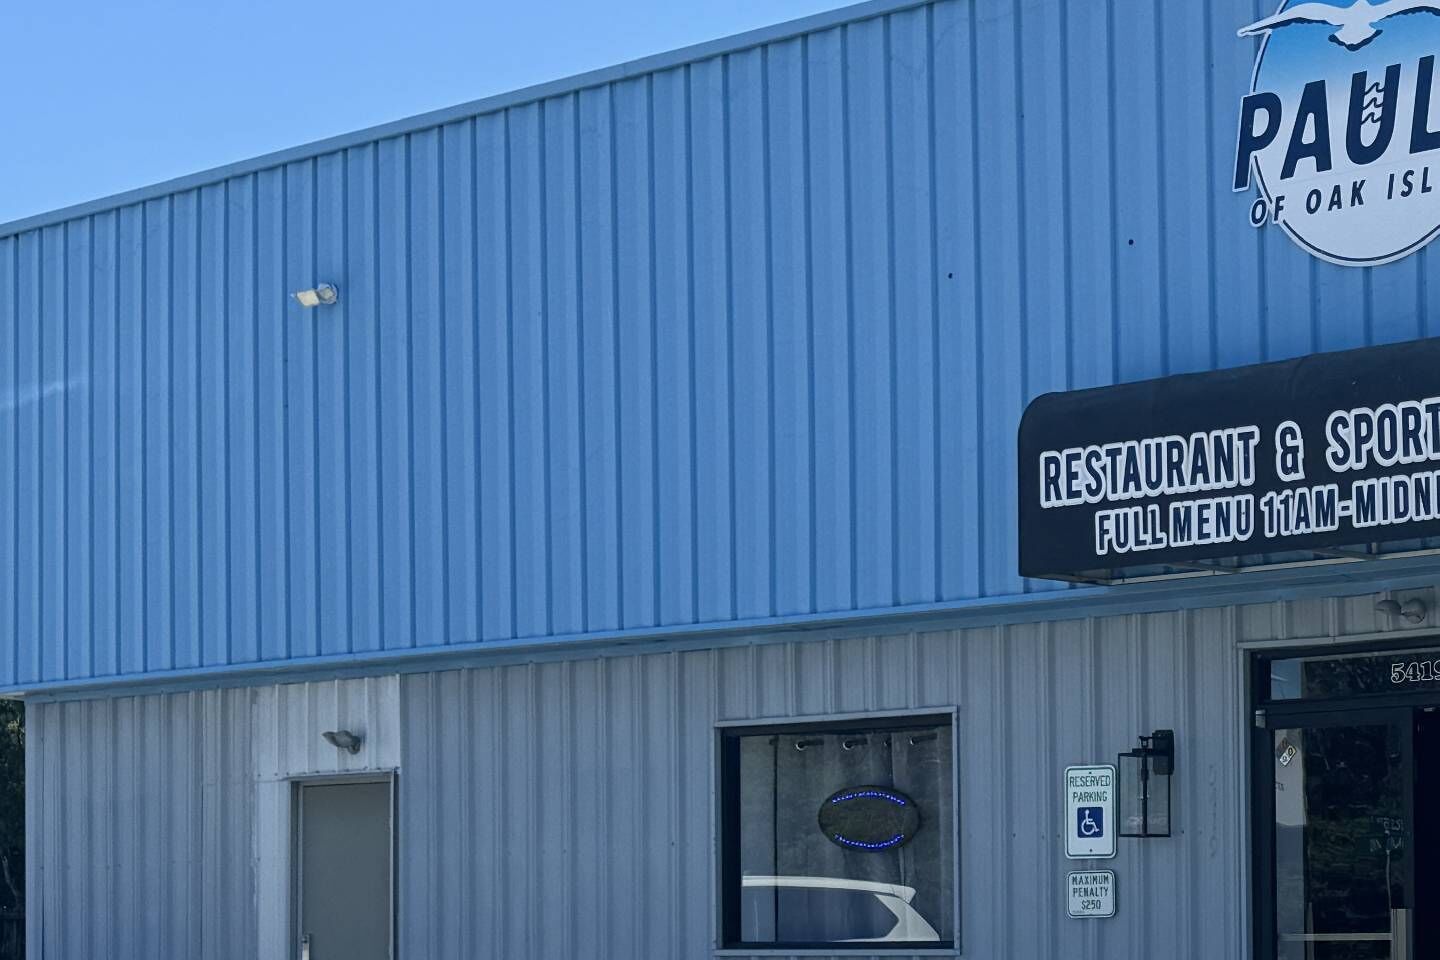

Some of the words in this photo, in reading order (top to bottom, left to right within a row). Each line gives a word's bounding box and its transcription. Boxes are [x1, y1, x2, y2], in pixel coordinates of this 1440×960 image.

[1251, 196, 1285, 225] OF
[1305, 180, 1366, 215] OAK
[1040, 425, 1260, 509] RESTAURANT
[1275, 420, 1304, 483] &
[1095, 504, 1166, 556] FULL
[1169, 493, 1255, 548] MENU
[1069, 775, 1111, 788] RESERVED
[1072, 791, 1108, 802] PARKING
[1072, 874, 1109, 886] MAXIMUM
[1072, 887, 1109, 898] PENALTY
[1081, 900, 1101, 911] $250
